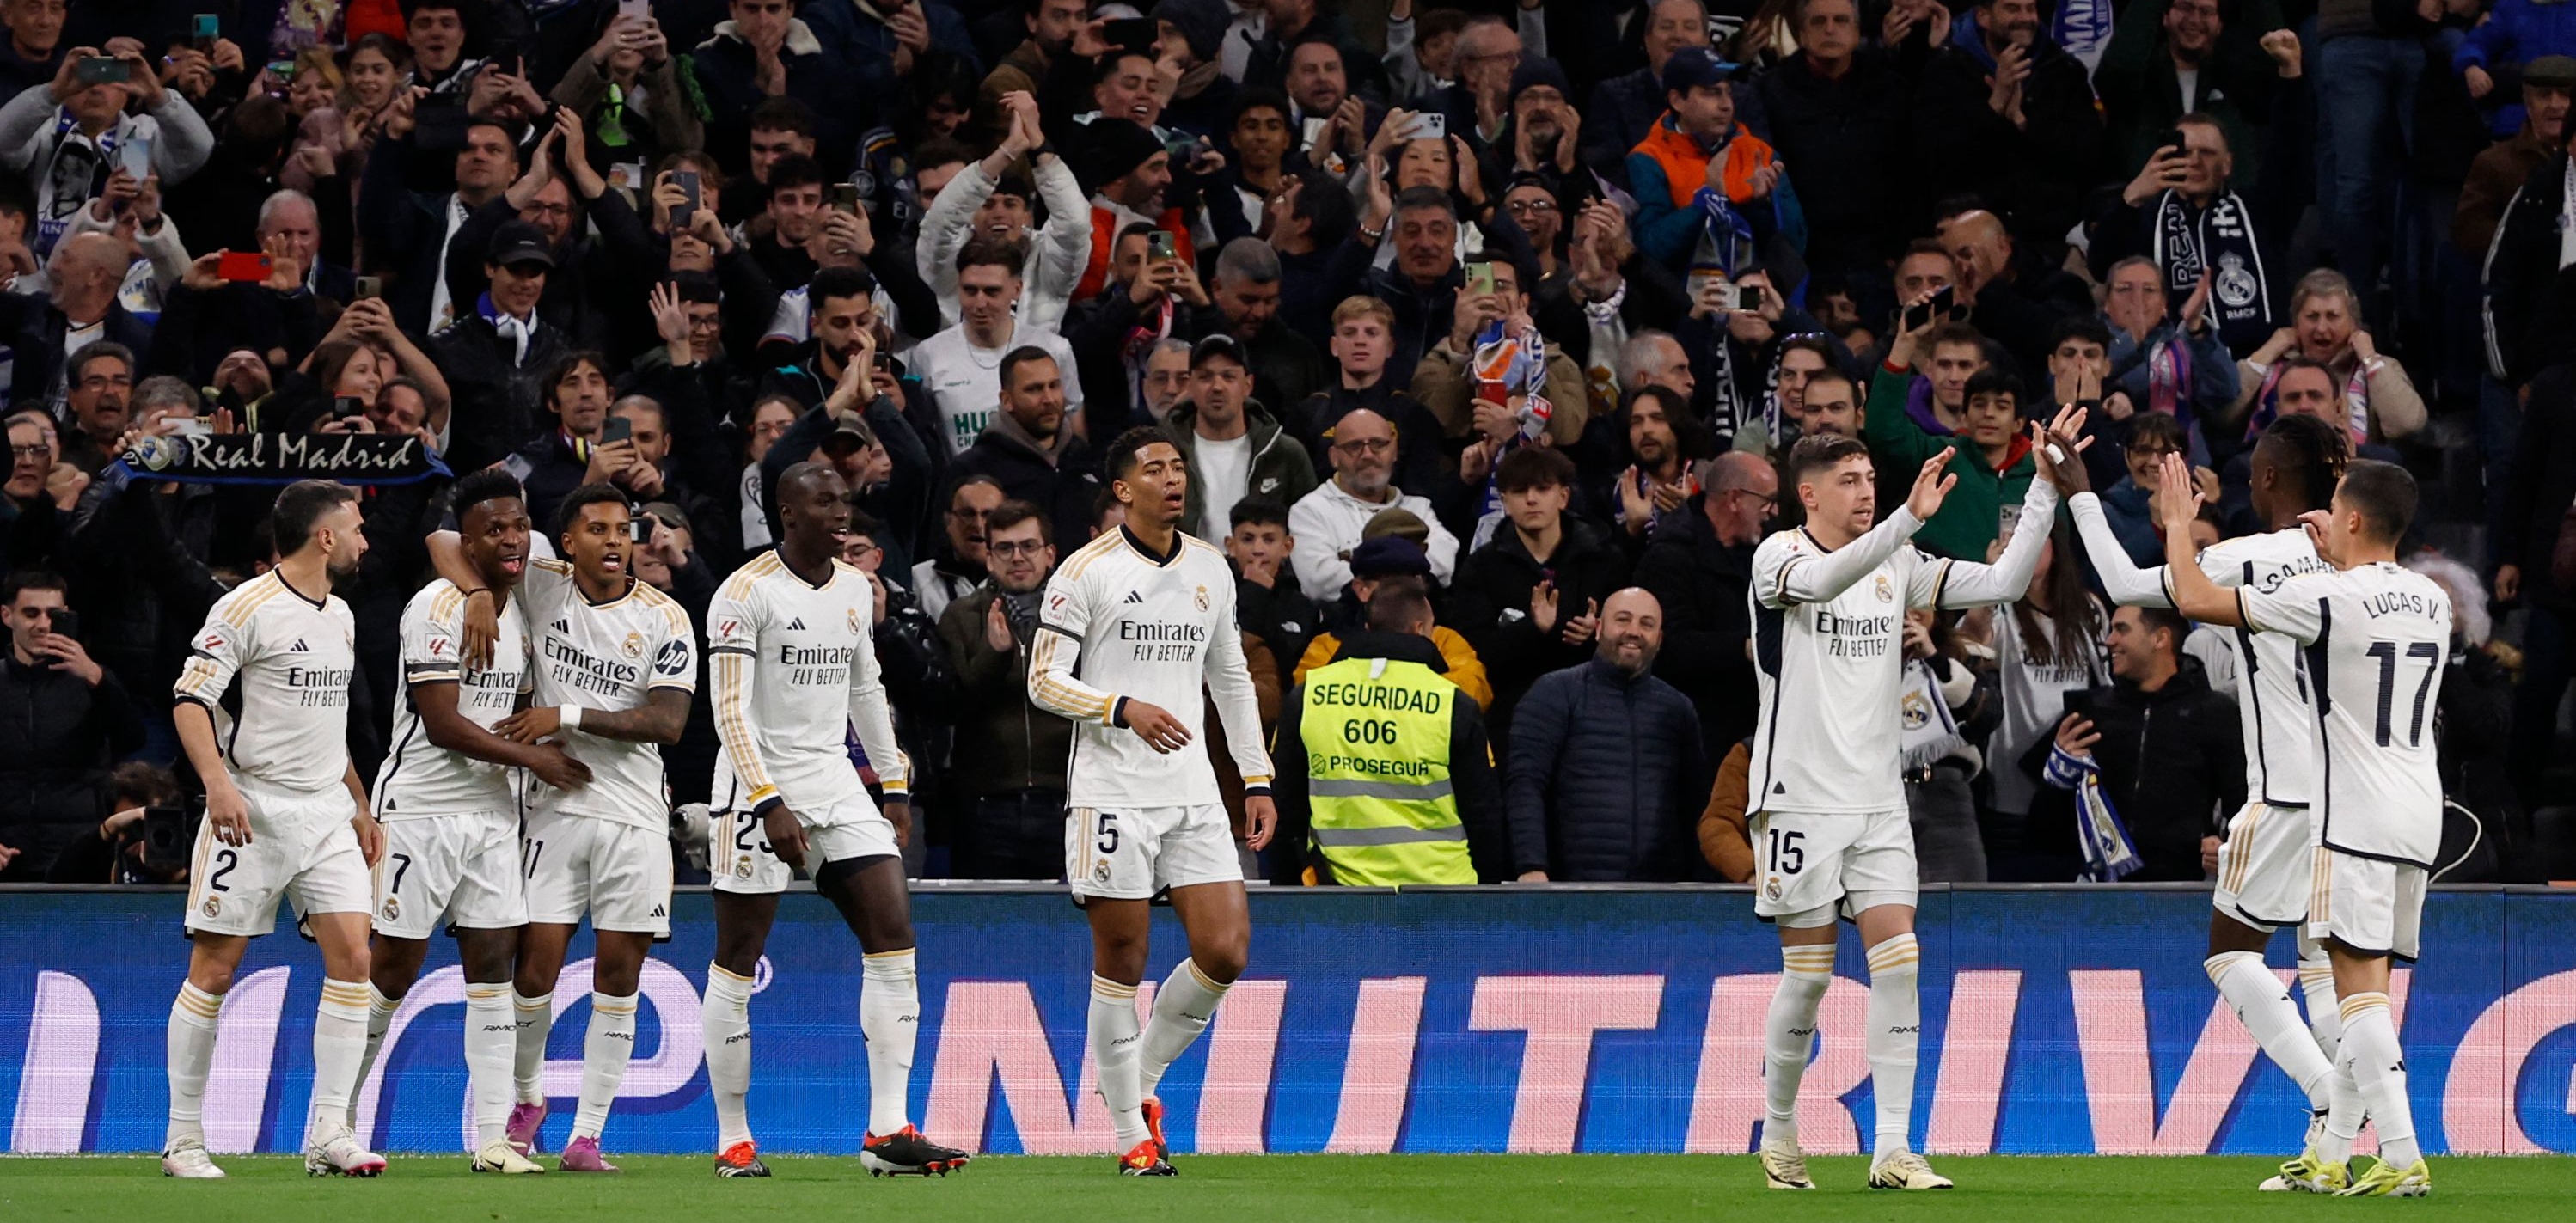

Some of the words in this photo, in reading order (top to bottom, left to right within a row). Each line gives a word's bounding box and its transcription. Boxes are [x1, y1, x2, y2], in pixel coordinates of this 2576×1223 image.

[187, 432, 266, 471] Real
[278, 432, 417, 470] Madrid
[957, 436, 976, 448] CH
[2363, 591, 2422, 619] LUCAS
[2429, 599, 2439, 624] V.
[1120, 620, 1205, 642] Emirates
[545, 635, 637, 682] Emirates
[657, 639, 689, 676] hp
[1134, 645, 1153, 661] FLY
[1158, 645, 1195, 662] BETTER
[552, 664, 572, 685] FLY
[575, 672, 621, 697] BETTER
[792, 669, 813, 685] FLY
[301, 690, 320, 706] FLY
[472, 691, 492, 707] FLY
[1312, 683, 1440, 714] SEGURIDAD
[2365, 642, 2439, 747] 17
[1344, 719, 1397, 744] 606
[1330, 755, 1429, 776] PROSEGUR
[1098, 813, 1117, 853] 5
[522, 838, 544, 879] 11
[1769, 829, 1805, 875] 15
[211, 849, 237, 892] 2
[391, 853, 411, 893] 7
